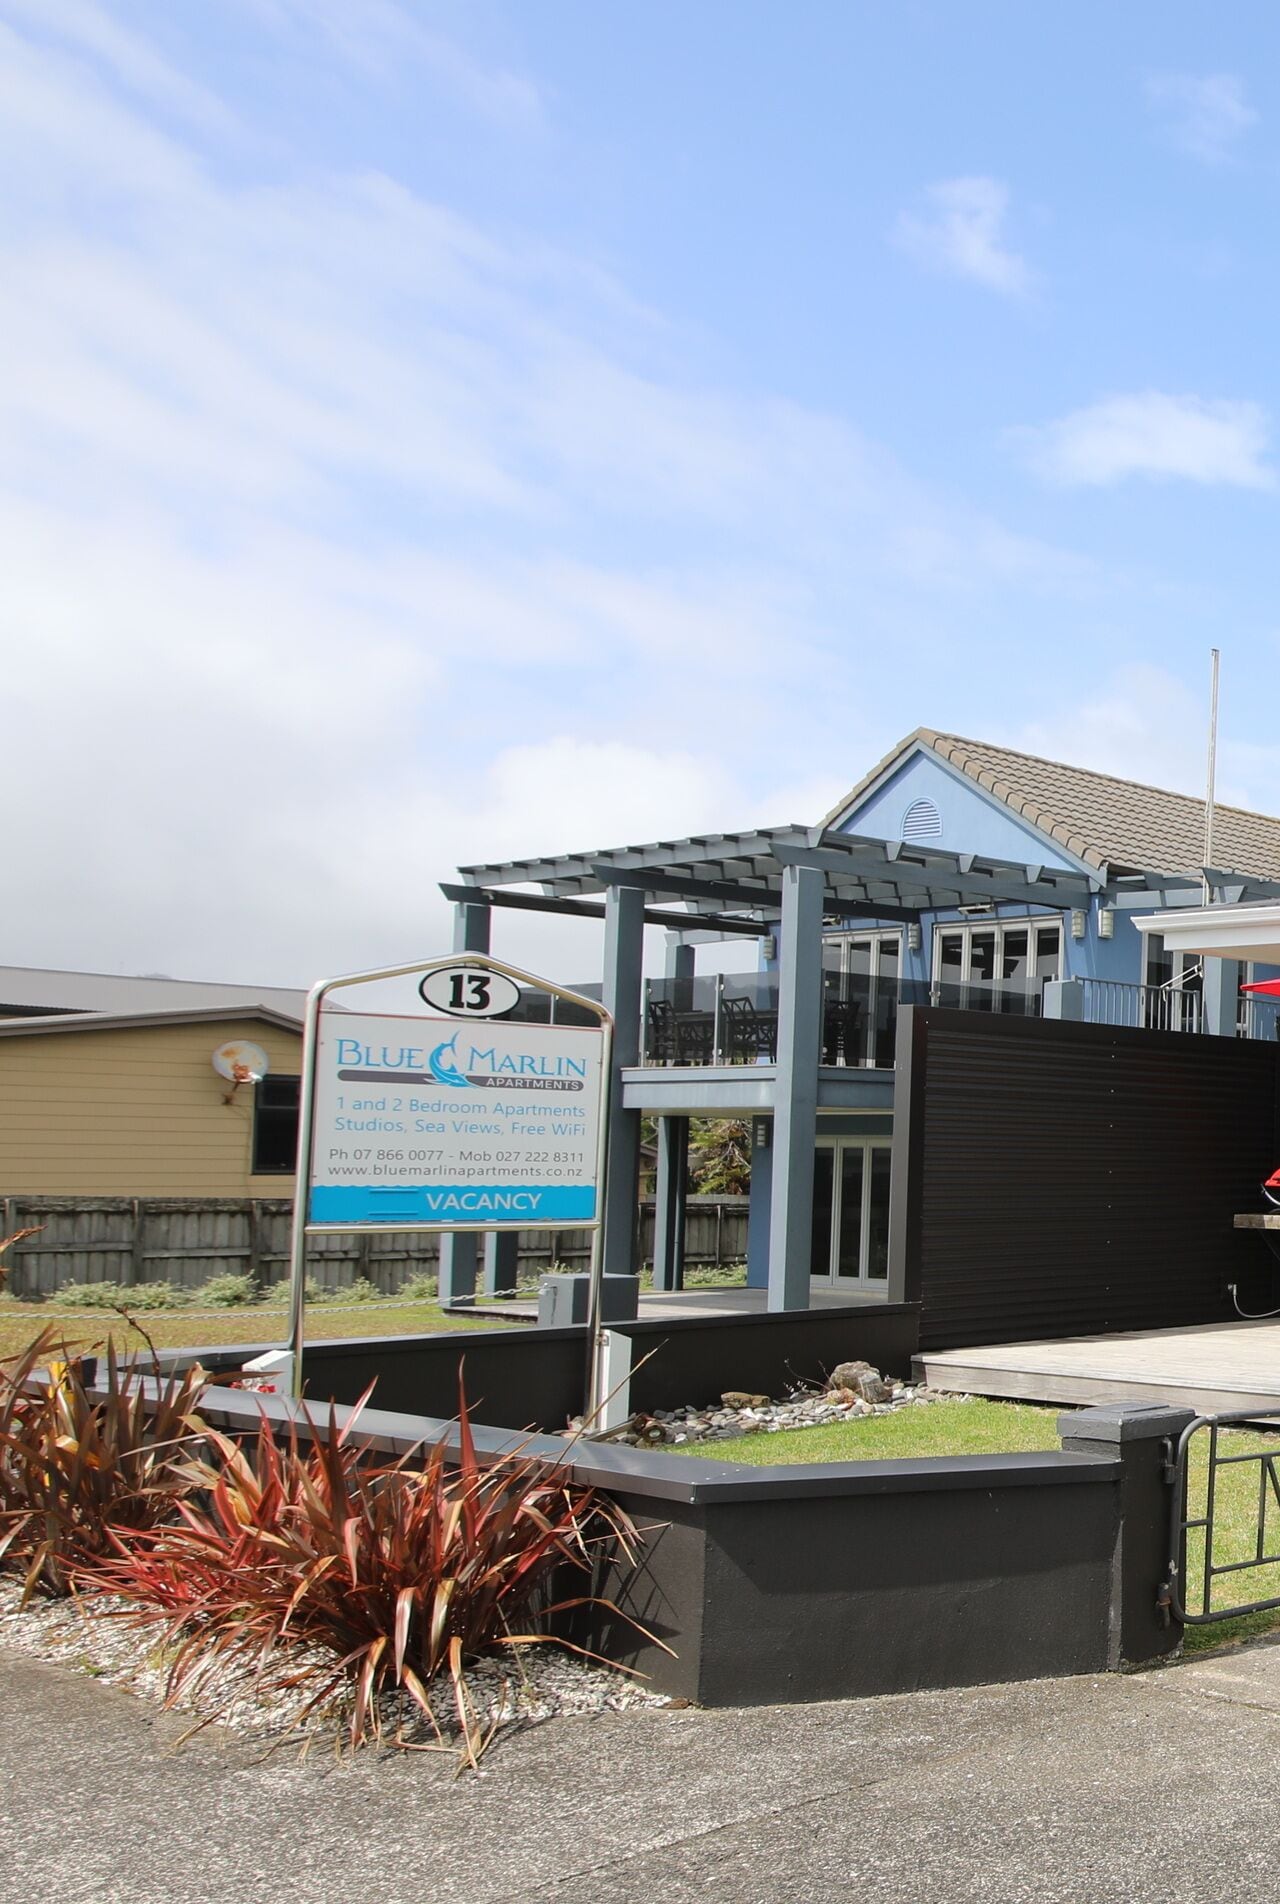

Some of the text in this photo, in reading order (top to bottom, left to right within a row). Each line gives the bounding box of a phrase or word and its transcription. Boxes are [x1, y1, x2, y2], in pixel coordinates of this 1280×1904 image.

[449, 974, 491, 1010] 13
[335, 1038, 587, 1077] BLUE MARLIN
[485, 1077, 580, 1091] APARTMENTS
[337, 1096, 586, 1118] 1 and 2 Bedroom Apartments
[335, 1117, 586, 1136] Studios, Sea Views, Free WiFi
[329, 1149, 349, 1160] Ph
[353, 1149, 372, 1160] 07
[376, 1149, 404, 1161] 866
[408, 1150, 444, 1161] 0077
[459, 1151, 492, 1162] Mob
[496, 1151, 521, 1162] 027
[525, 1152, 550, 1162] 222
[553, 1152, 584, 1163] 8311
[328, 1164, 583, 1178] www.bluemarlinapartments.co.nz
[426, 1193, 542, 1210] VACANCY
